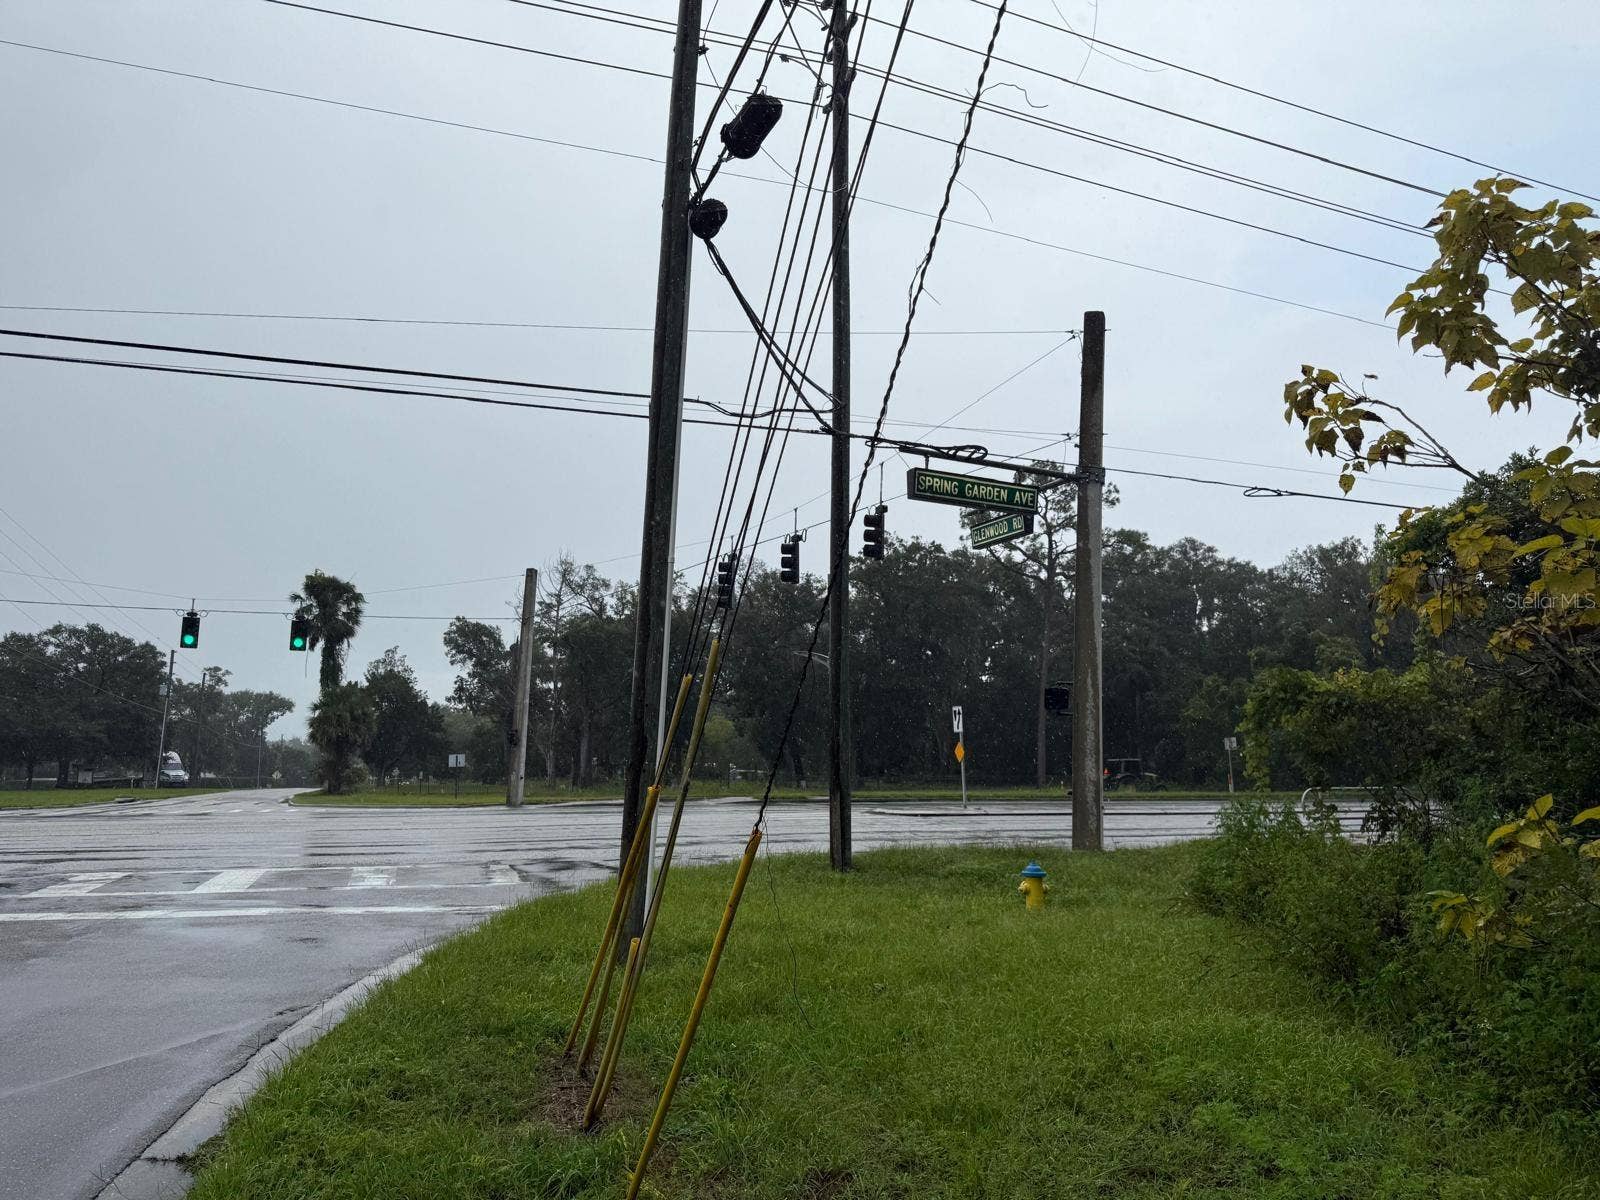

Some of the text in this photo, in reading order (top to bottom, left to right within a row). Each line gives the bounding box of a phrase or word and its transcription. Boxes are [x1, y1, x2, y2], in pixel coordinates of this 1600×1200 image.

[919, 475, 1035, 506] SPRING GARDEN AVE
[973, 515, 1023, 542] GLENWOOD RD
